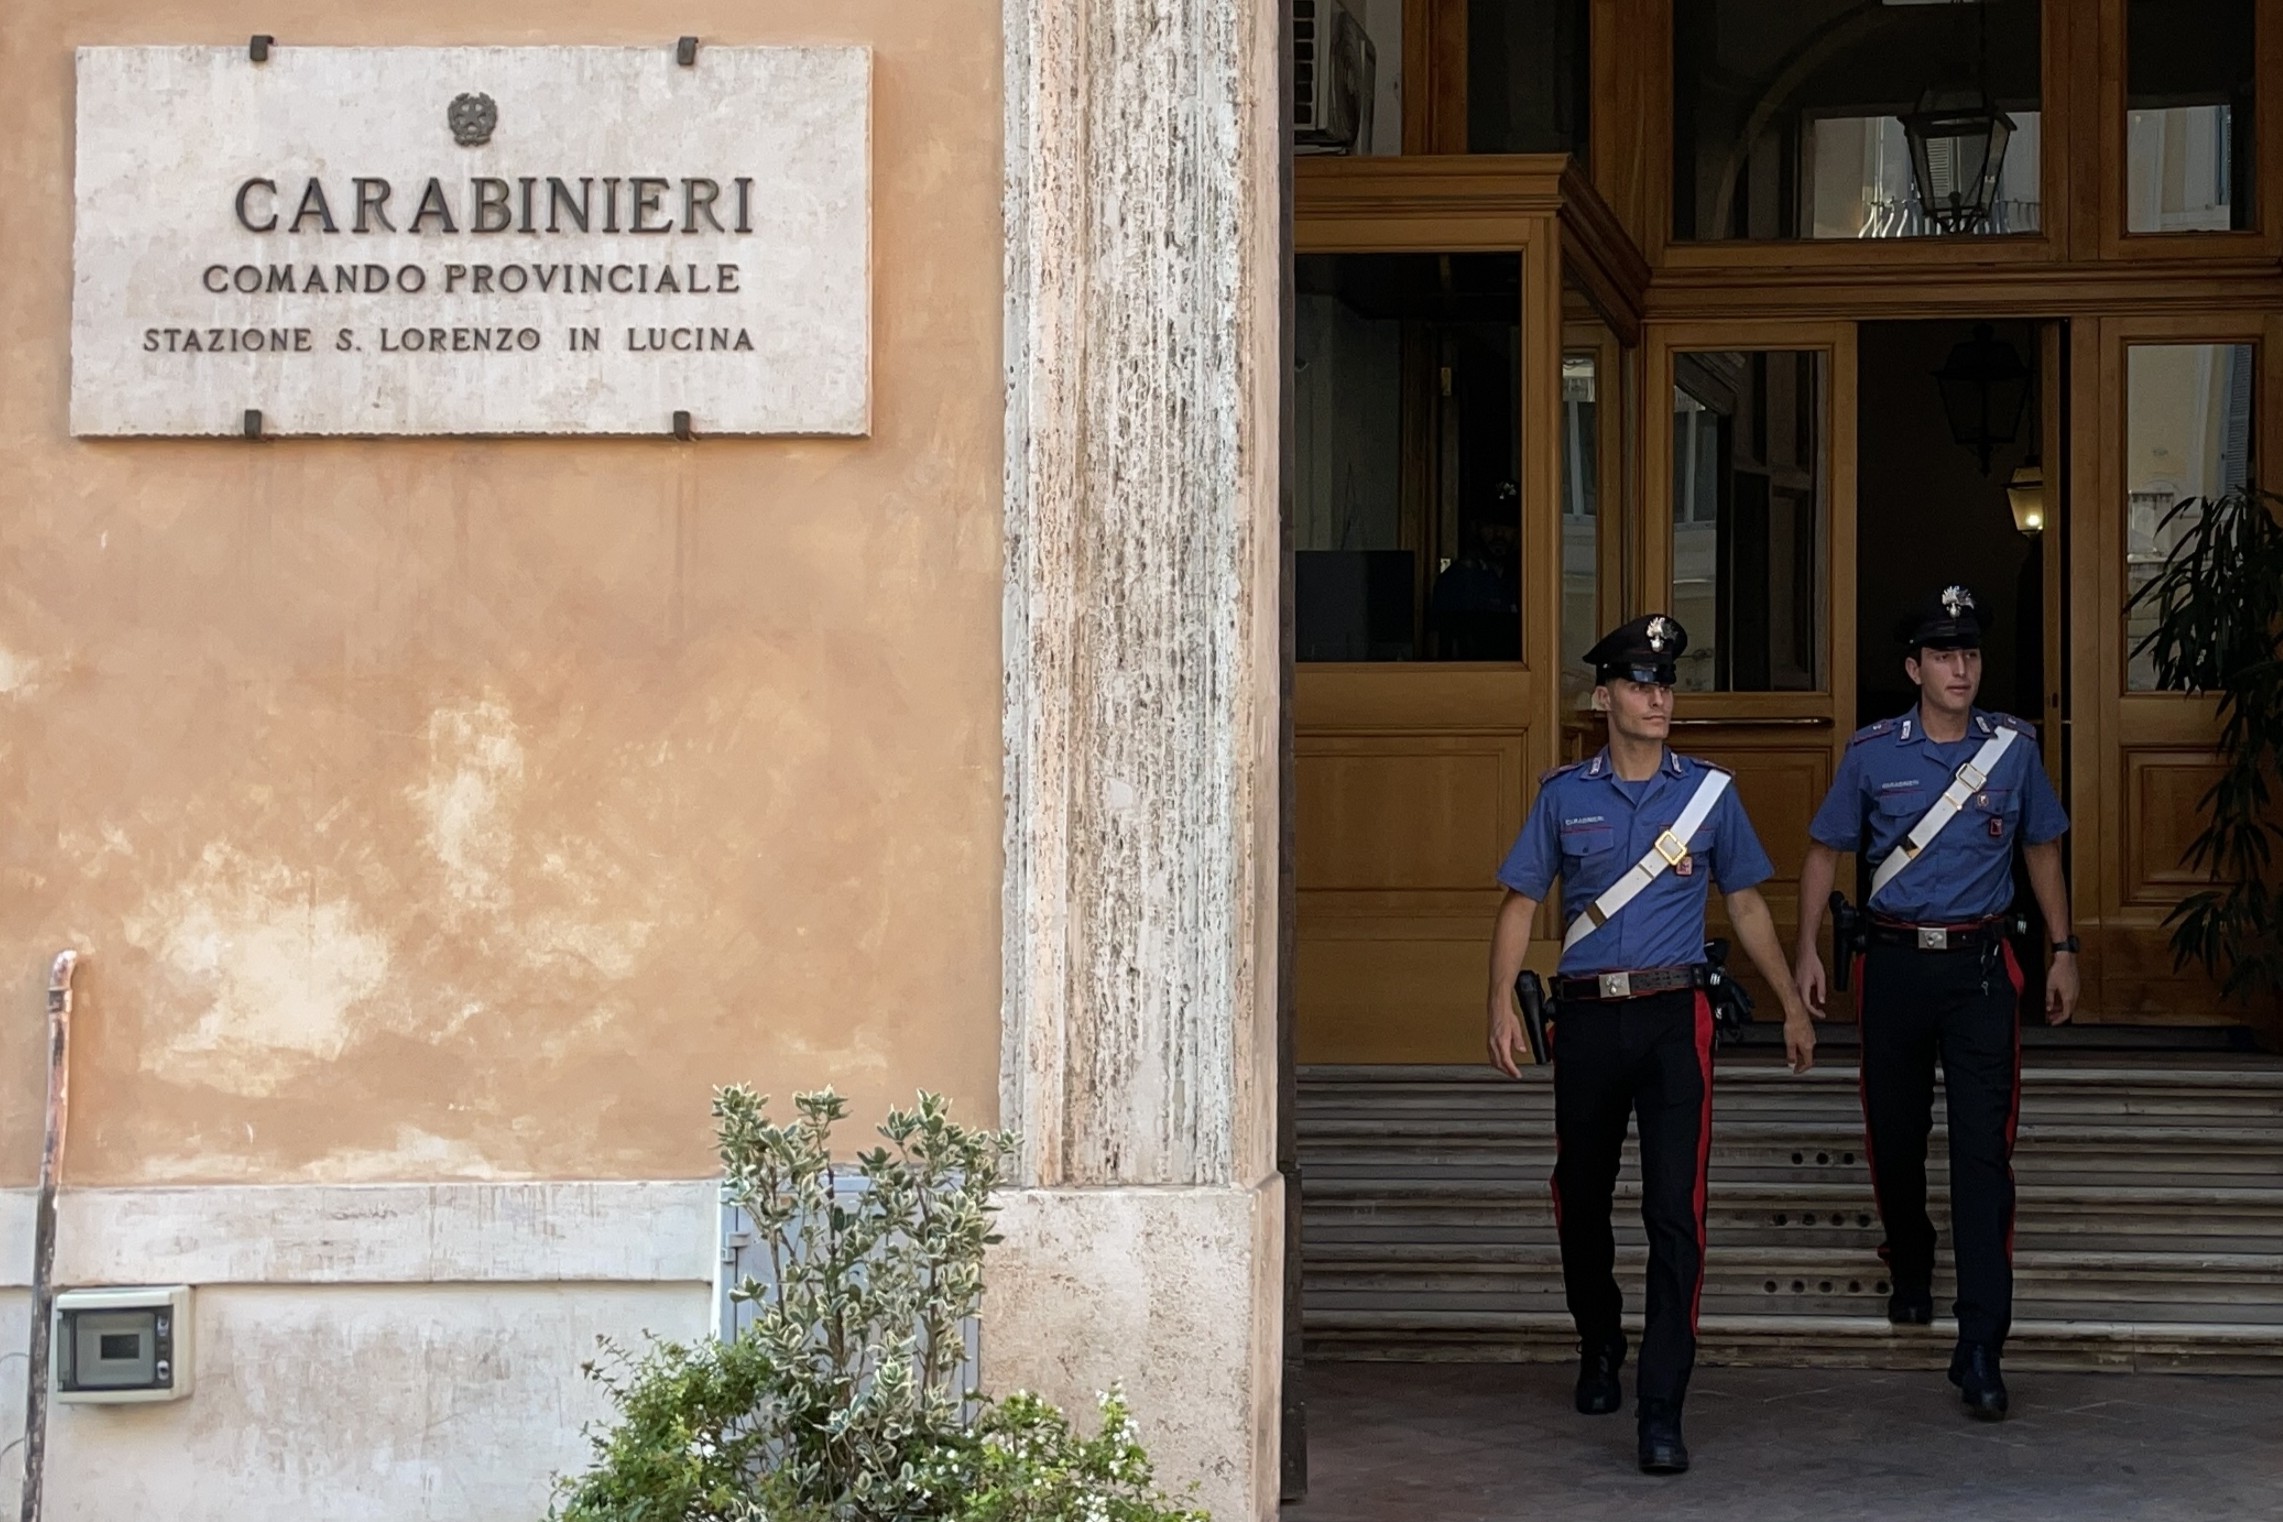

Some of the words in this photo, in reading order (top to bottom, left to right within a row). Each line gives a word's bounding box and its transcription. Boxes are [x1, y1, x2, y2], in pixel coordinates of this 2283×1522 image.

[235, 177, 753, 234] CARABINIERI
[202, 264, 426, 294] COMANDO
[444, 264, 740, 294] PROVINCIALE
[143, 328, 312, 352] STAZIONE
[336, 328, 363, 352] S.
[380, 327, 541, 352] LORENZO
[568, 327, 600, 351] IN
[628, 327, 754, 351] LUCINA
